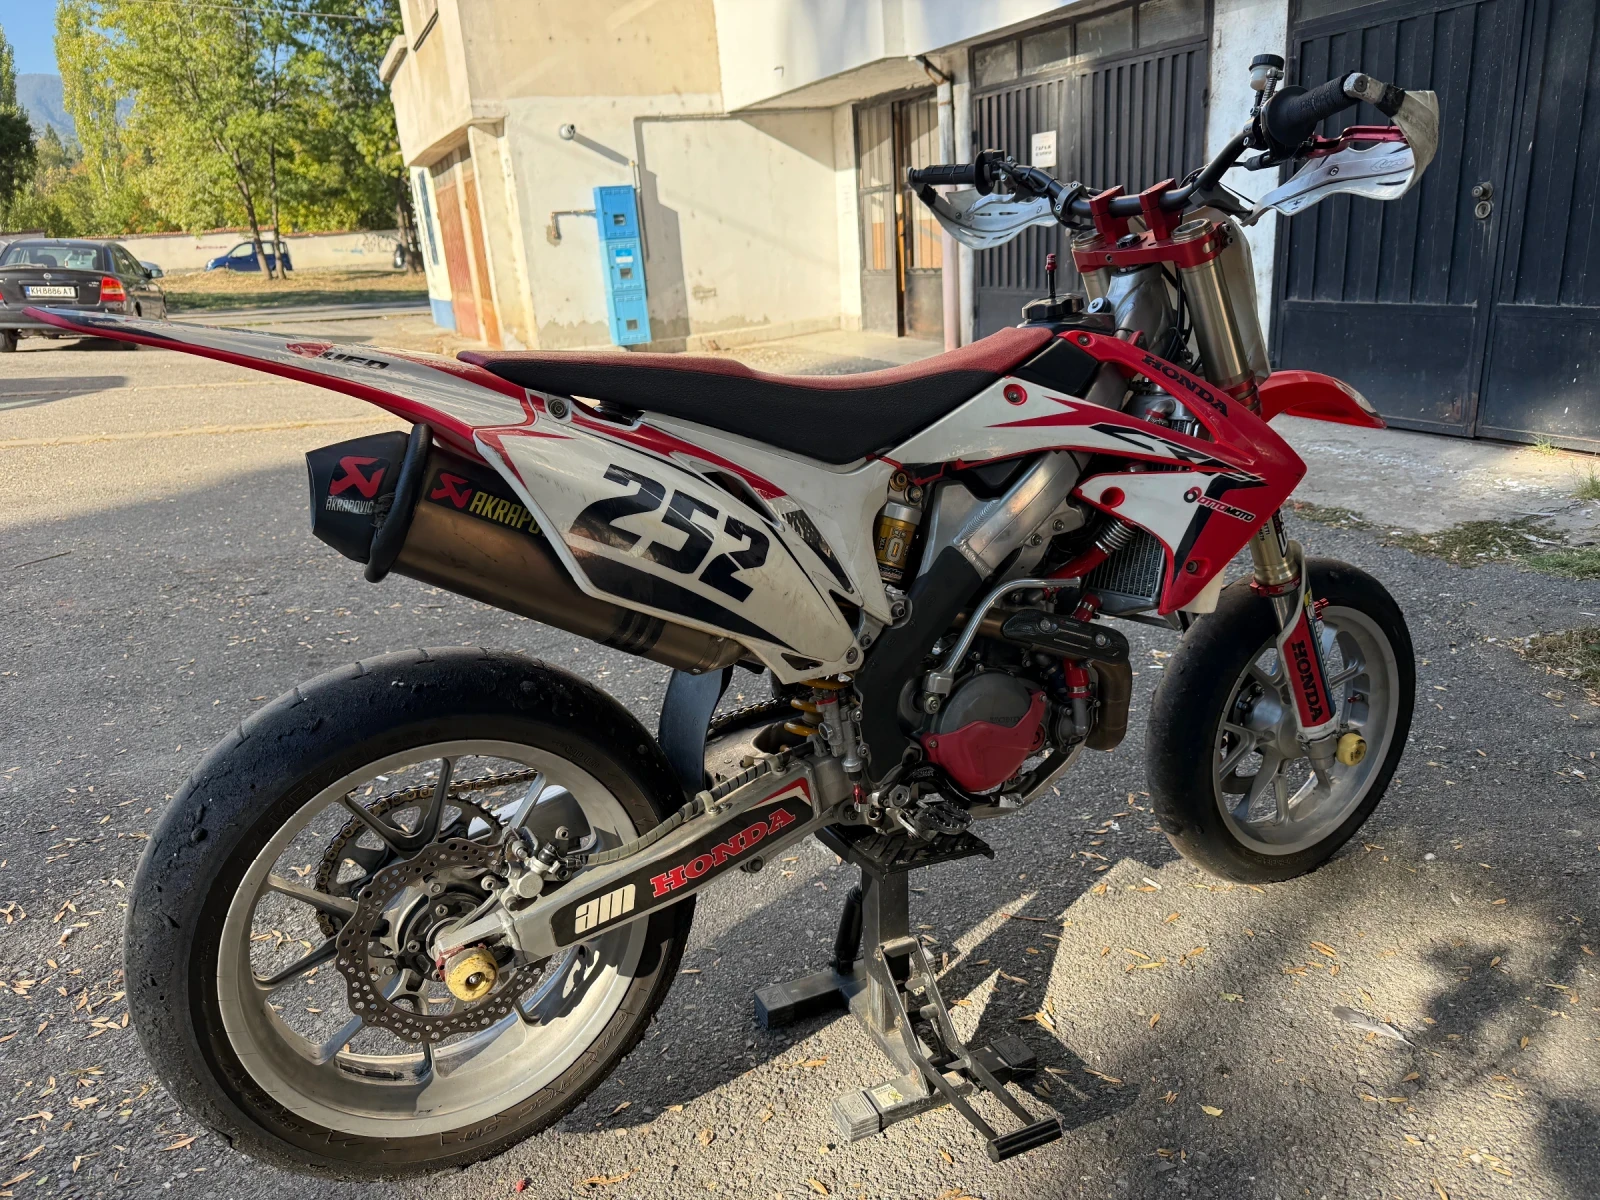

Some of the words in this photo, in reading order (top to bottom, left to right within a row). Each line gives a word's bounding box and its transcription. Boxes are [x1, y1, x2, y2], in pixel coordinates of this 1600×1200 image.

[1142, 354, 1228, 418] HONDA
[569, 463, 770, 603] 252
[1291, 639, 1324, 723] HONDA
[650, 807, 796, 898] HONDA
